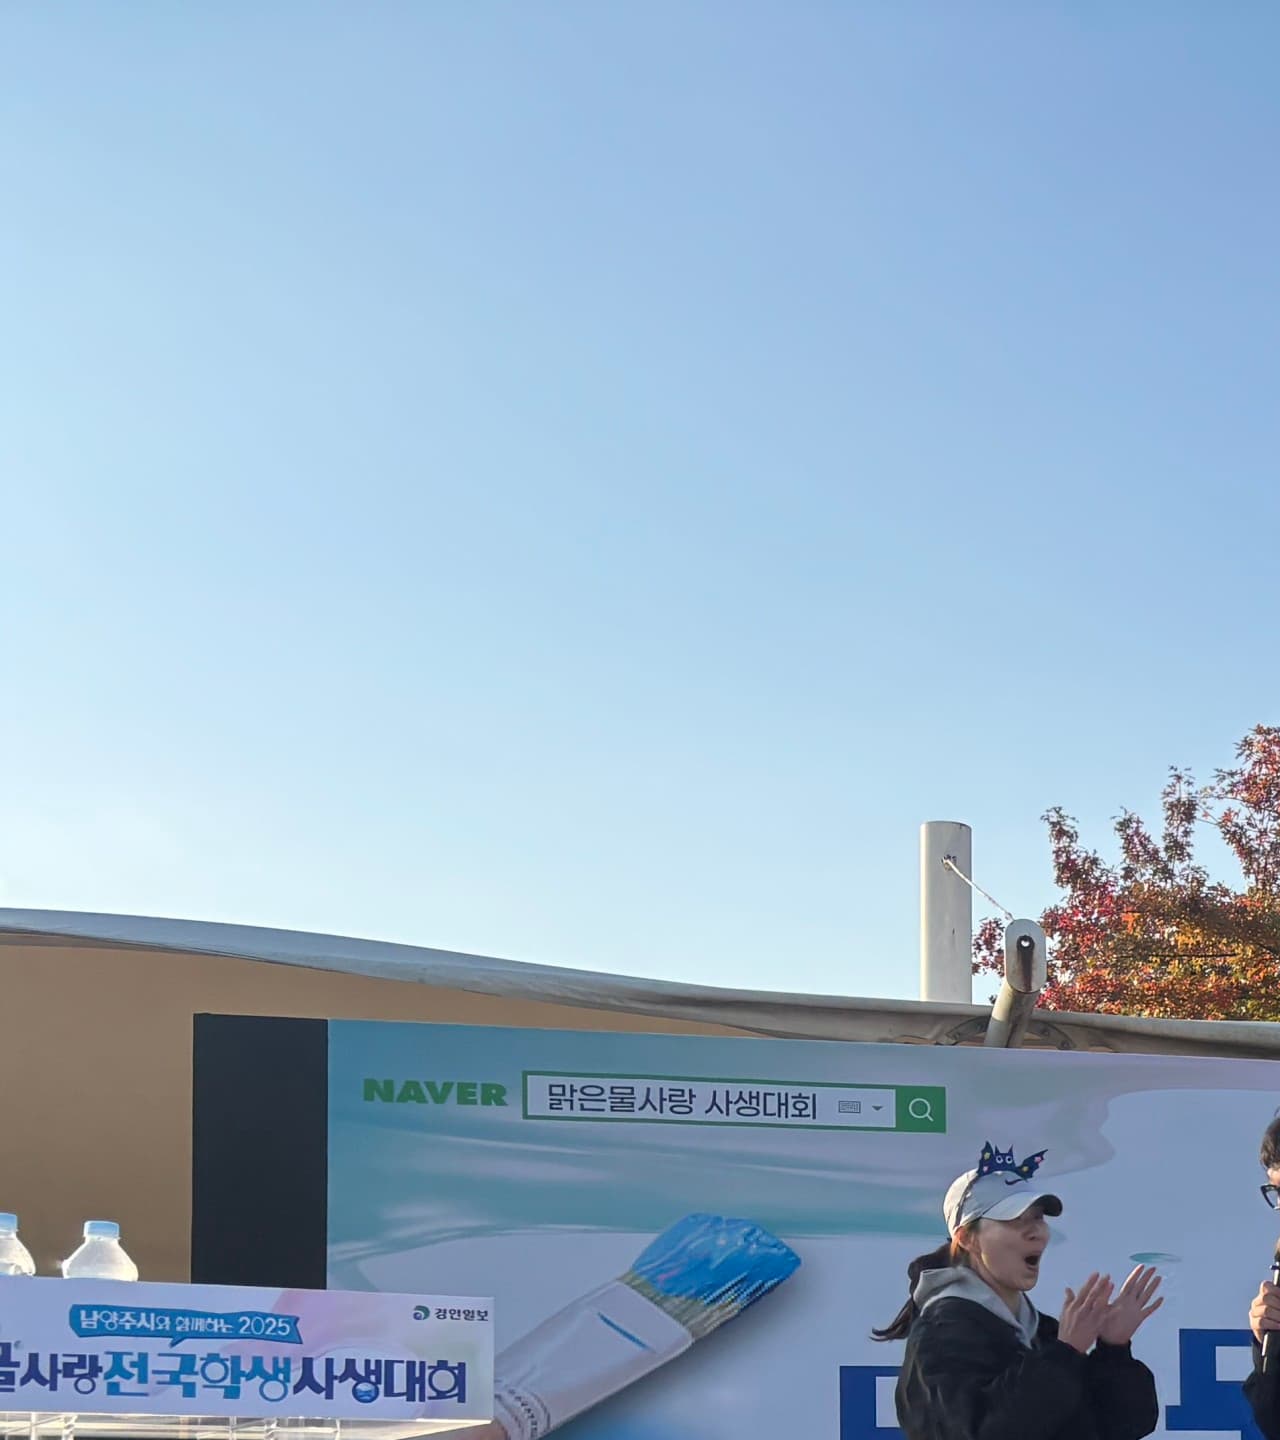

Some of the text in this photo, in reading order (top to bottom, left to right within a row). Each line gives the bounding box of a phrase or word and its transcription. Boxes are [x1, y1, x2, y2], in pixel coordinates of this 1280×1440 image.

[363, 1078, 508, 1107] NAVER
[547, 1083, 818, 1120] 맑은물사랑 사생대회
[79, 1308, 170, 1331] 남양주시와
[239, 1316, 291, 1337] 2025
[435, 1307, 489, 1322] 경인일보
